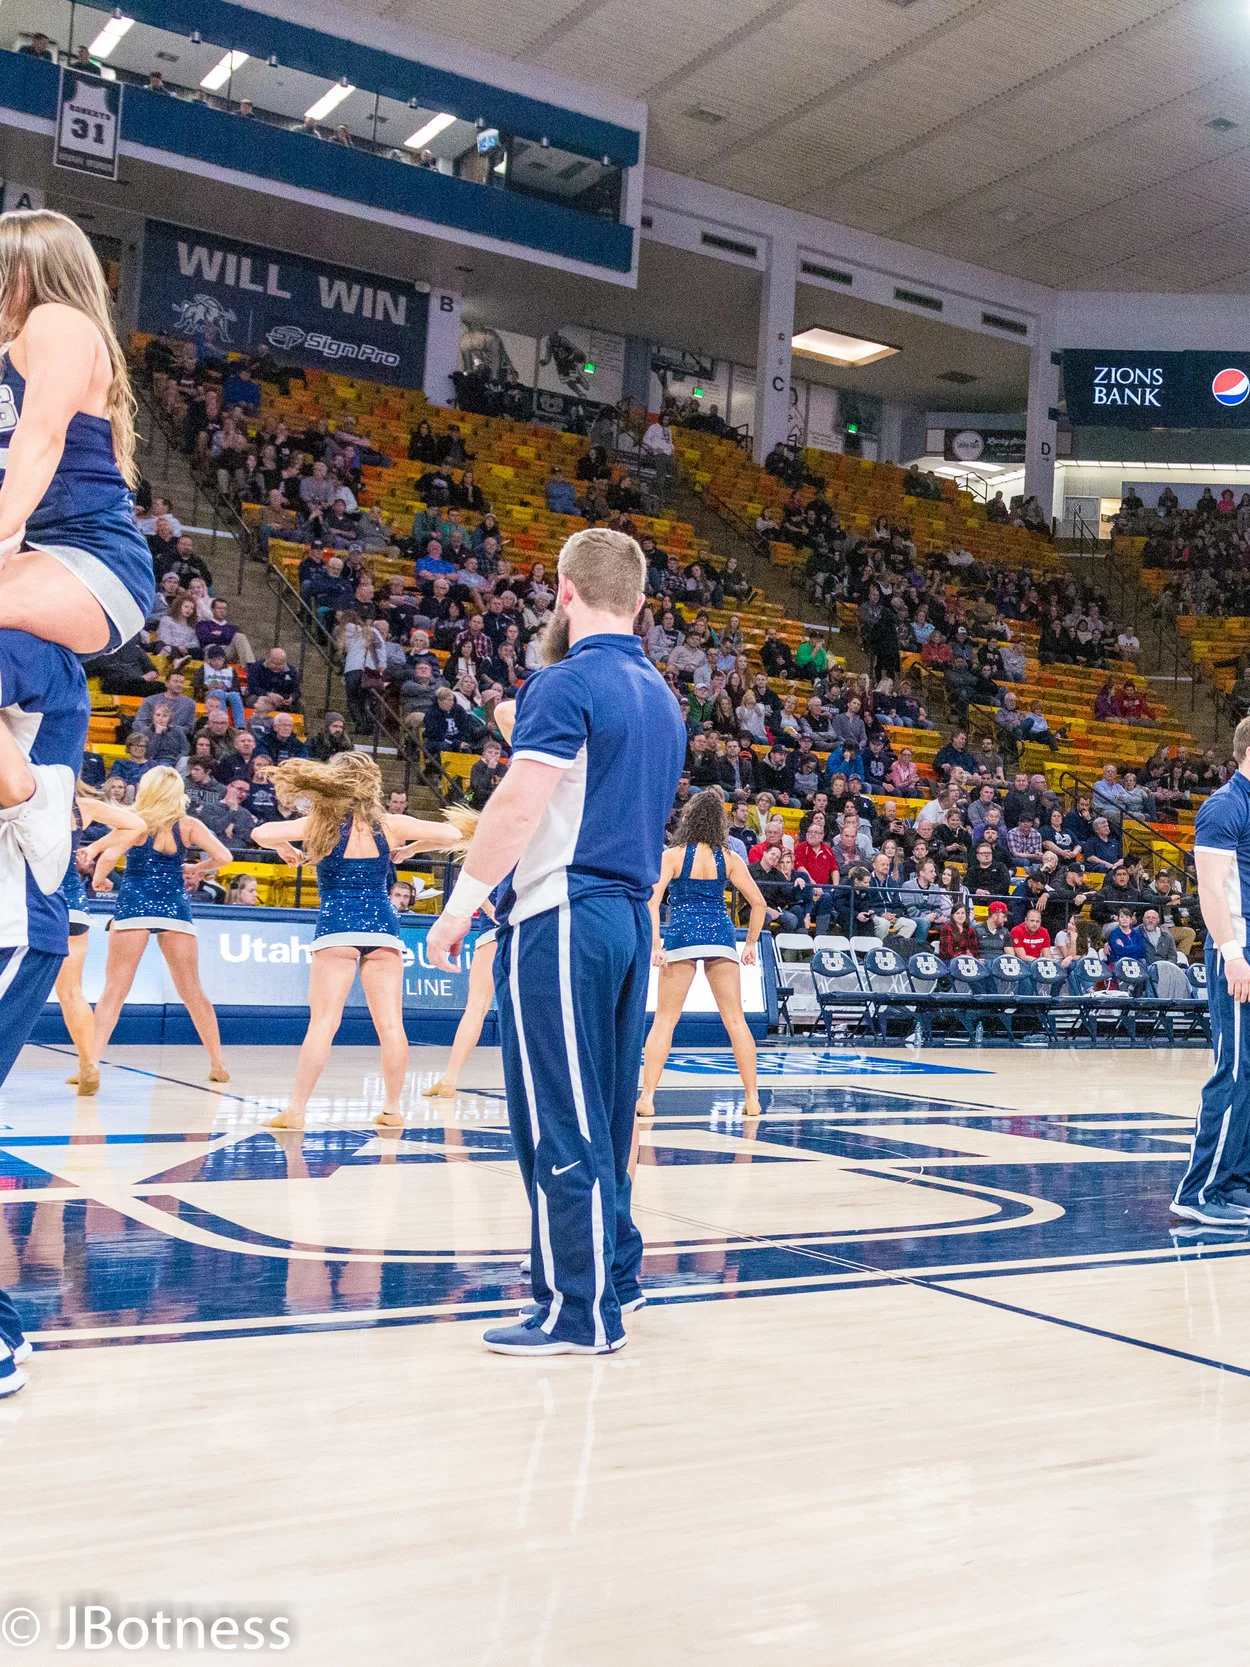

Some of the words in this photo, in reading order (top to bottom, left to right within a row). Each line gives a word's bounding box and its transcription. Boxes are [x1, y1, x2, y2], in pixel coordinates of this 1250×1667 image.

[71, 117, 105, 145] 31
[177, 241, 291, 299] WILL
[318, 275, 407, 326] WIN
[439, 295, 454, 313] B
[305, 332, 358, 360] Sign
[358, 344, 400, 367] Pro
[772, 375, 785, 392] C
[1093, 366, 1164, 385] ZIONS
[1093, 386, 1162, 407] BANK
[1041, 442, 1051, 455] D
[219, 933, 313, 965] Utah
[405, 978, 453, 996] LINE
